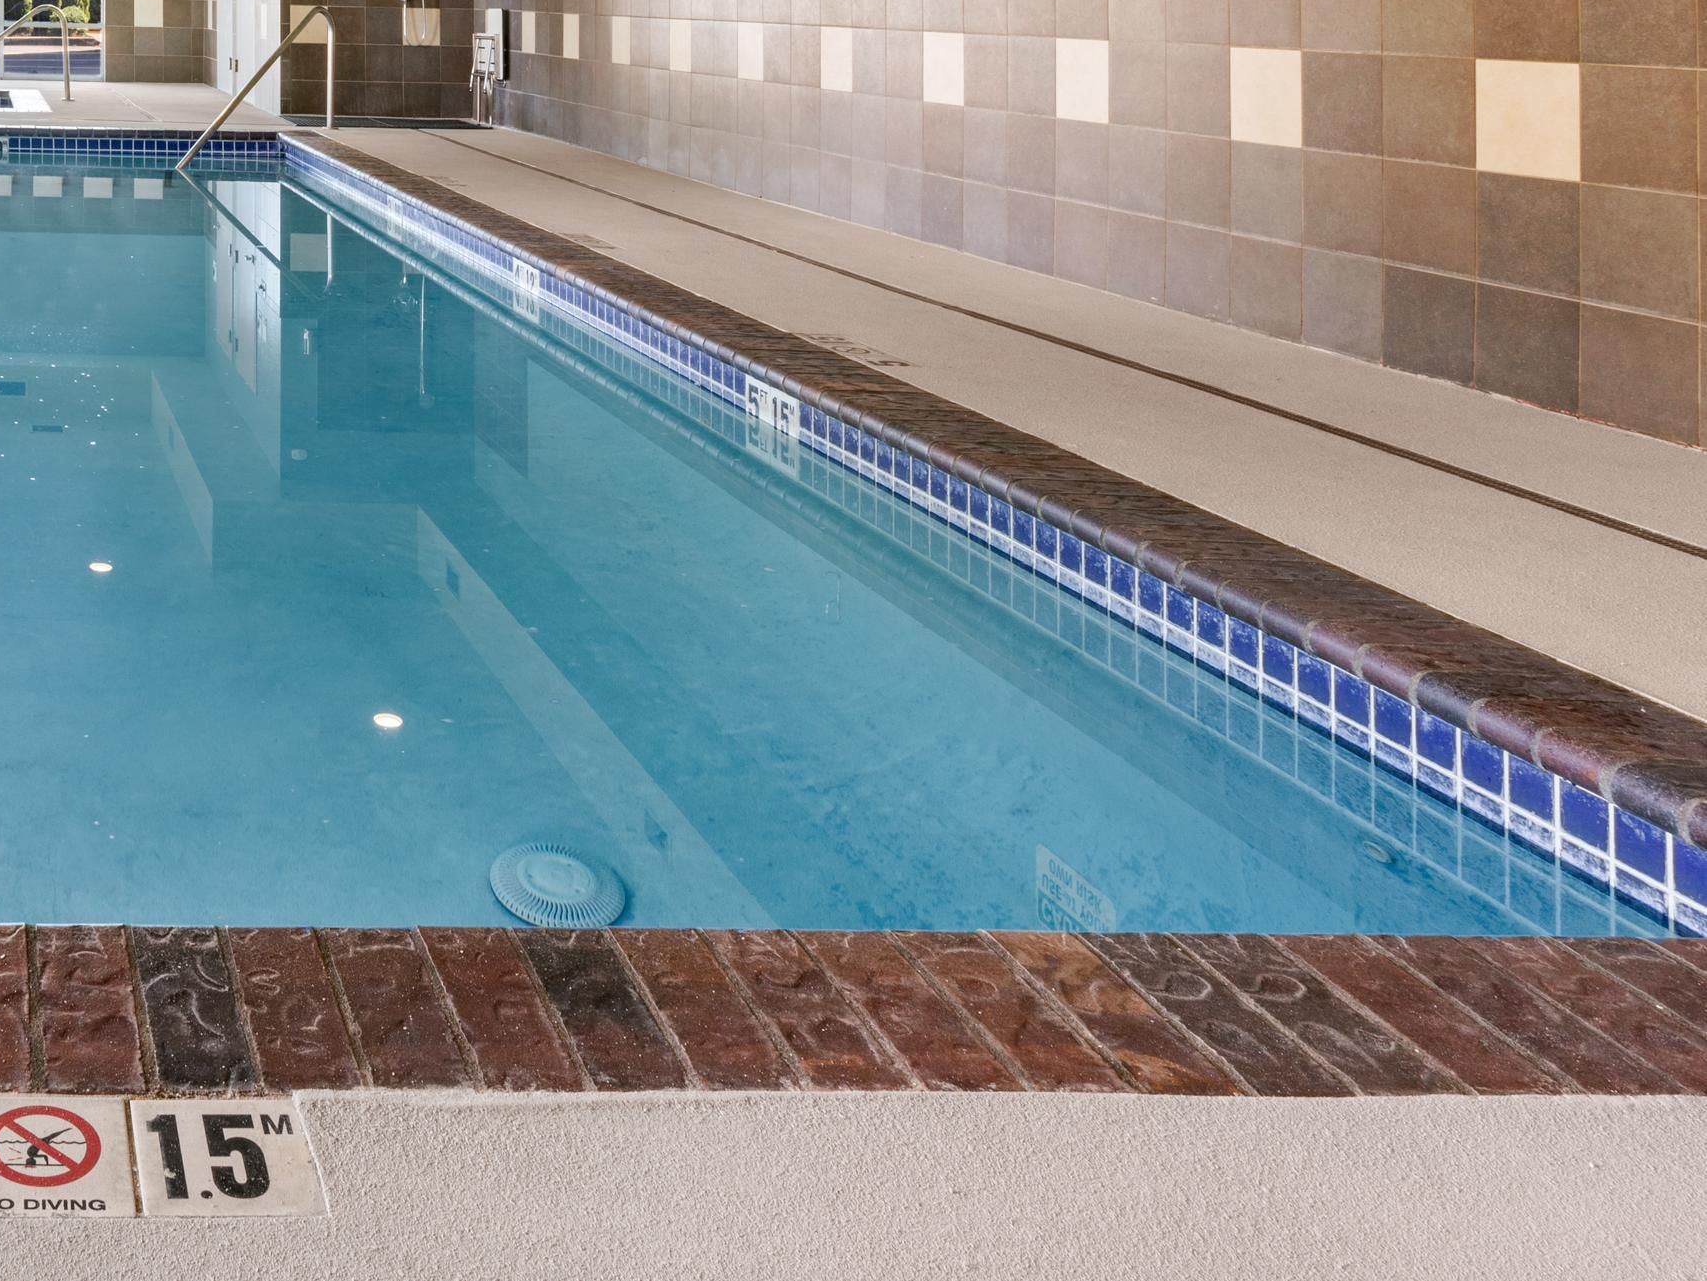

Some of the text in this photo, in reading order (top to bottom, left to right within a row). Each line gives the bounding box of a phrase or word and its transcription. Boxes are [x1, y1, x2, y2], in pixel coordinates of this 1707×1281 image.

[748, 383, 768, 419] 5 FT
[146, 1113, 294, 1200] 1.5 M
[23, 1198, 107, 1212] DIVING
